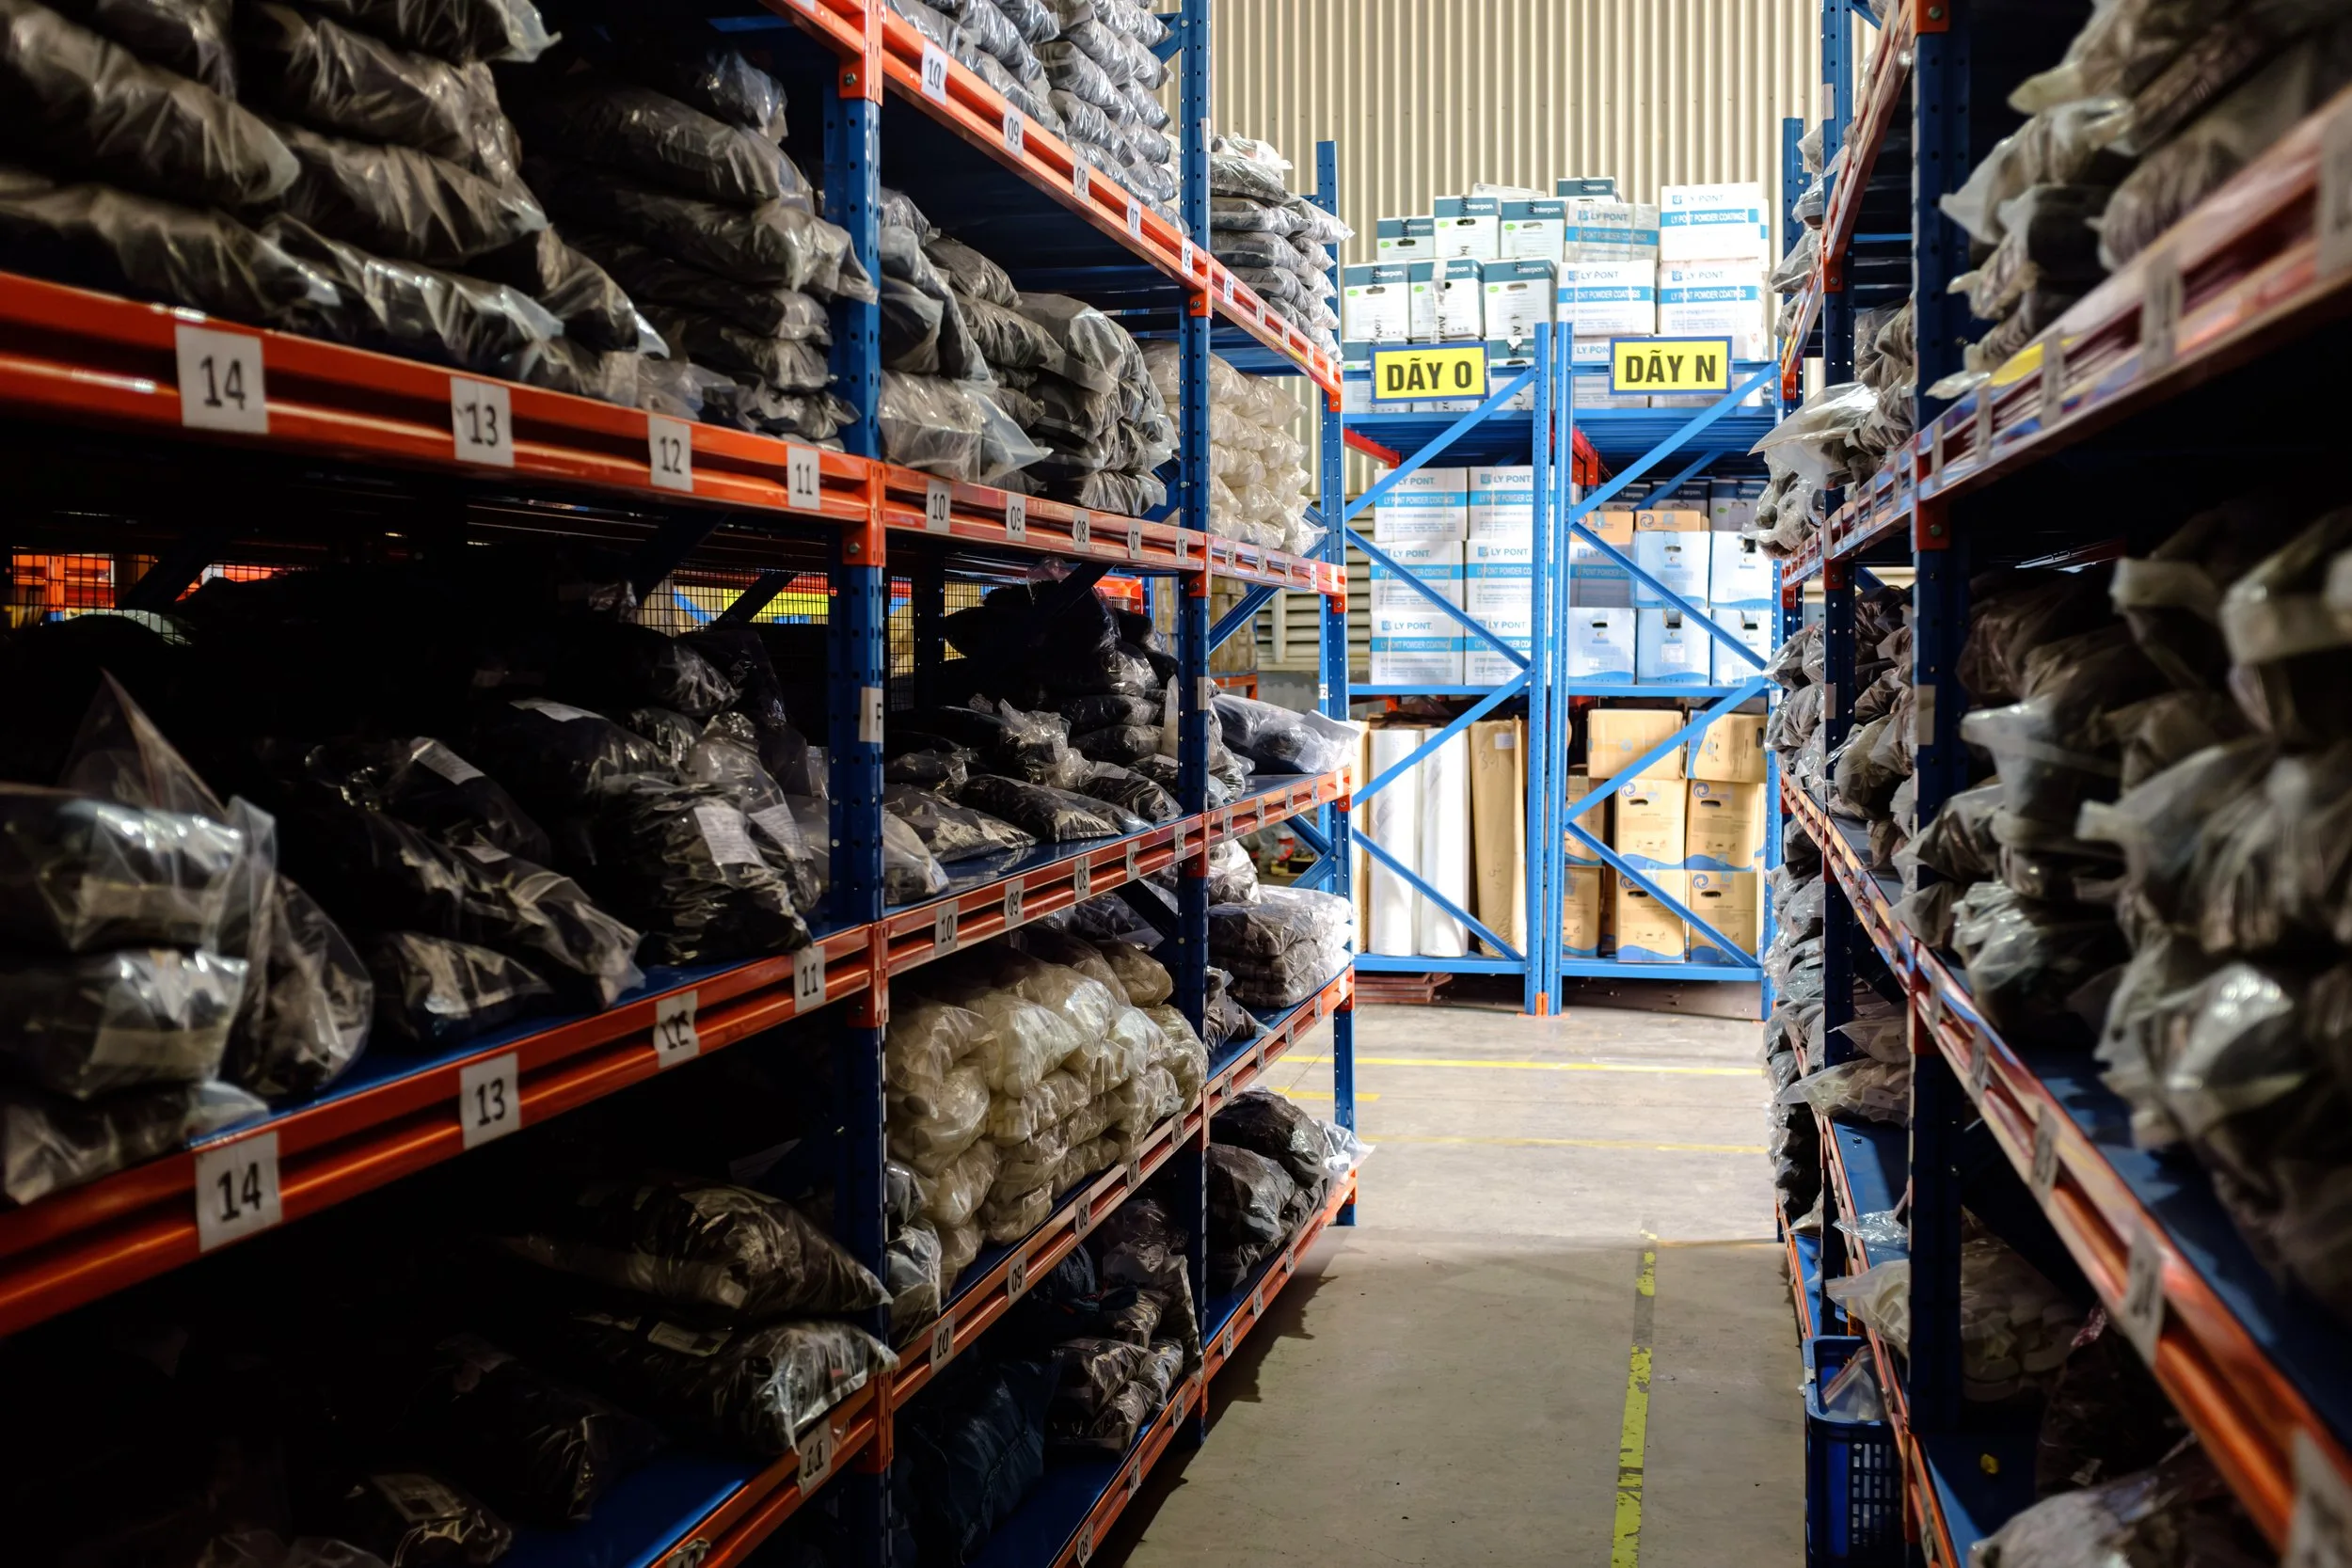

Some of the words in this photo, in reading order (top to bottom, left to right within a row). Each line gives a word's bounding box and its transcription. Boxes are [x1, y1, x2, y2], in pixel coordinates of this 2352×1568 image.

[928, 59, 942, 91] 10
[1008, 117, 1019, 146] 09
[1076, 166, 1087, 192] 08
[1130, 207, 1138, 229] 07
[1603, 213, 1629, 221] PONT
[1594, 271, 1618, 279] PONT
[1577, 346, 1587, 355] LY
[1589, 345, 1610, 354] PON
[1387, 357, 1443, 391] DÃY
[1454, 360, 1472, 388] O
[1626, 350, 1684, 383] DÃY
[1695, 355, 1716, 382] N
[200, 356, 246, 412] 14
[469, 403, 499, 447] 13
[660, 436, 682, 473] 12
[796, 463, 813, 496] 11
[1410, 477, 1435, 485] PONT
[932, 492, 946, 522] 10
[1010, 506, 1022, 531] 09
[1076, 519, 1087, 543] 08
[1131, 531, 1139, 551] 07
[1502, 621, 1527, 629] PONT
[1077, 867, 1088, 891] 08
[1008, 890, 1019, 916] 09
[942, 913, 953, 942] 10
[802, 962, 818, 997] 11
[475, 1077, 505, 1127] 13
[1130, 1160, 1137, 1182] 07
[217, 1162, 262, 1222] 14
[1079, 1202, 1088, 1229] 08
[1011, 1263, 1023, 1292] 09
[936, 1326, 949, 1360] 10
